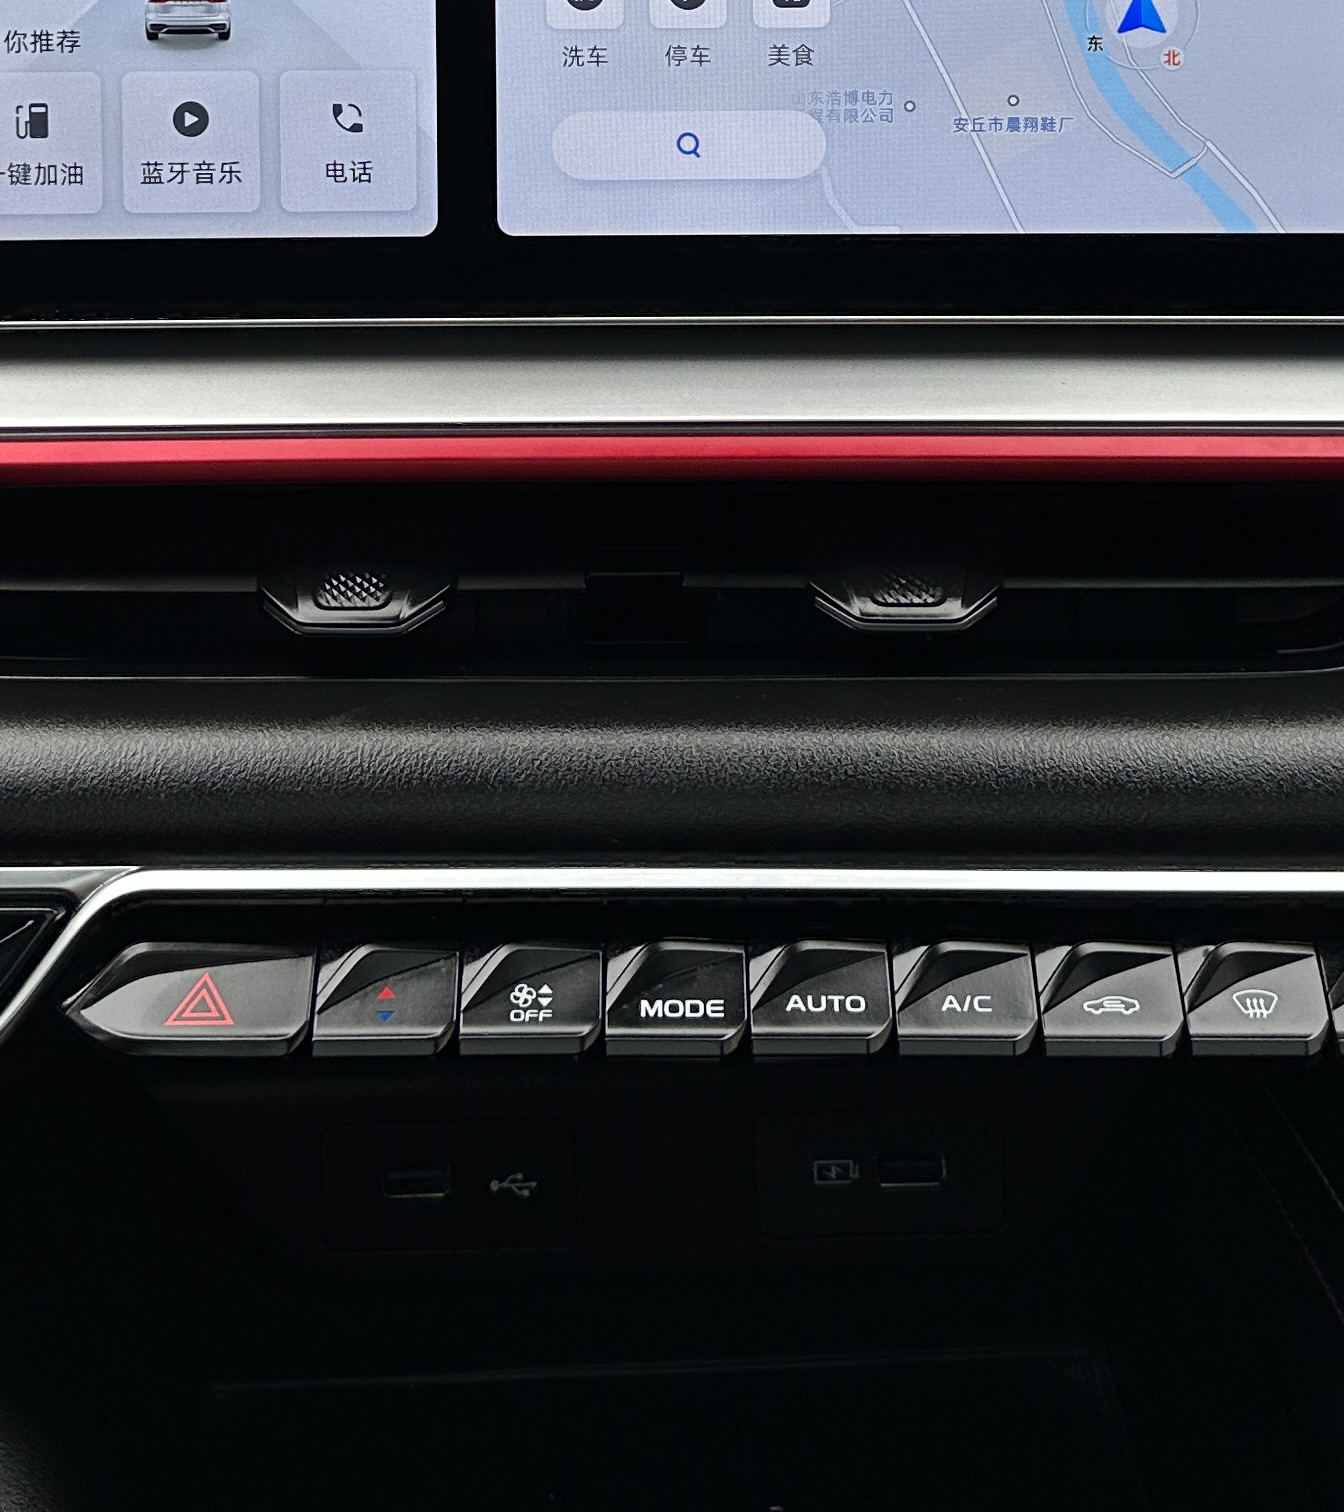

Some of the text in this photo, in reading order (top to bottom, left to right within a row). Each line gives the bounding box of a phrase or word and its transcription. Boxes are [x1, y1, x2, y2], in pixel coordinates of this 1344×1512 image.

[1087, 35, 1104, 52] 东
[561, 44, 609, 67] 洗车
[664, 44, 712, 67] 停车
[767, 43, 815, 67] 美食
[1163, 49, 1181, 67] 北
[139, 160, 244, 185] 蓝牙音乐
[325, 159, 374, 184] 电话
[638, 997, 726, 1019] MODE
[784, 992, 867, 1014] AUTO
[940, 992, 993, 1014] A/C
[508, 1008, 554, 1024] OFF
